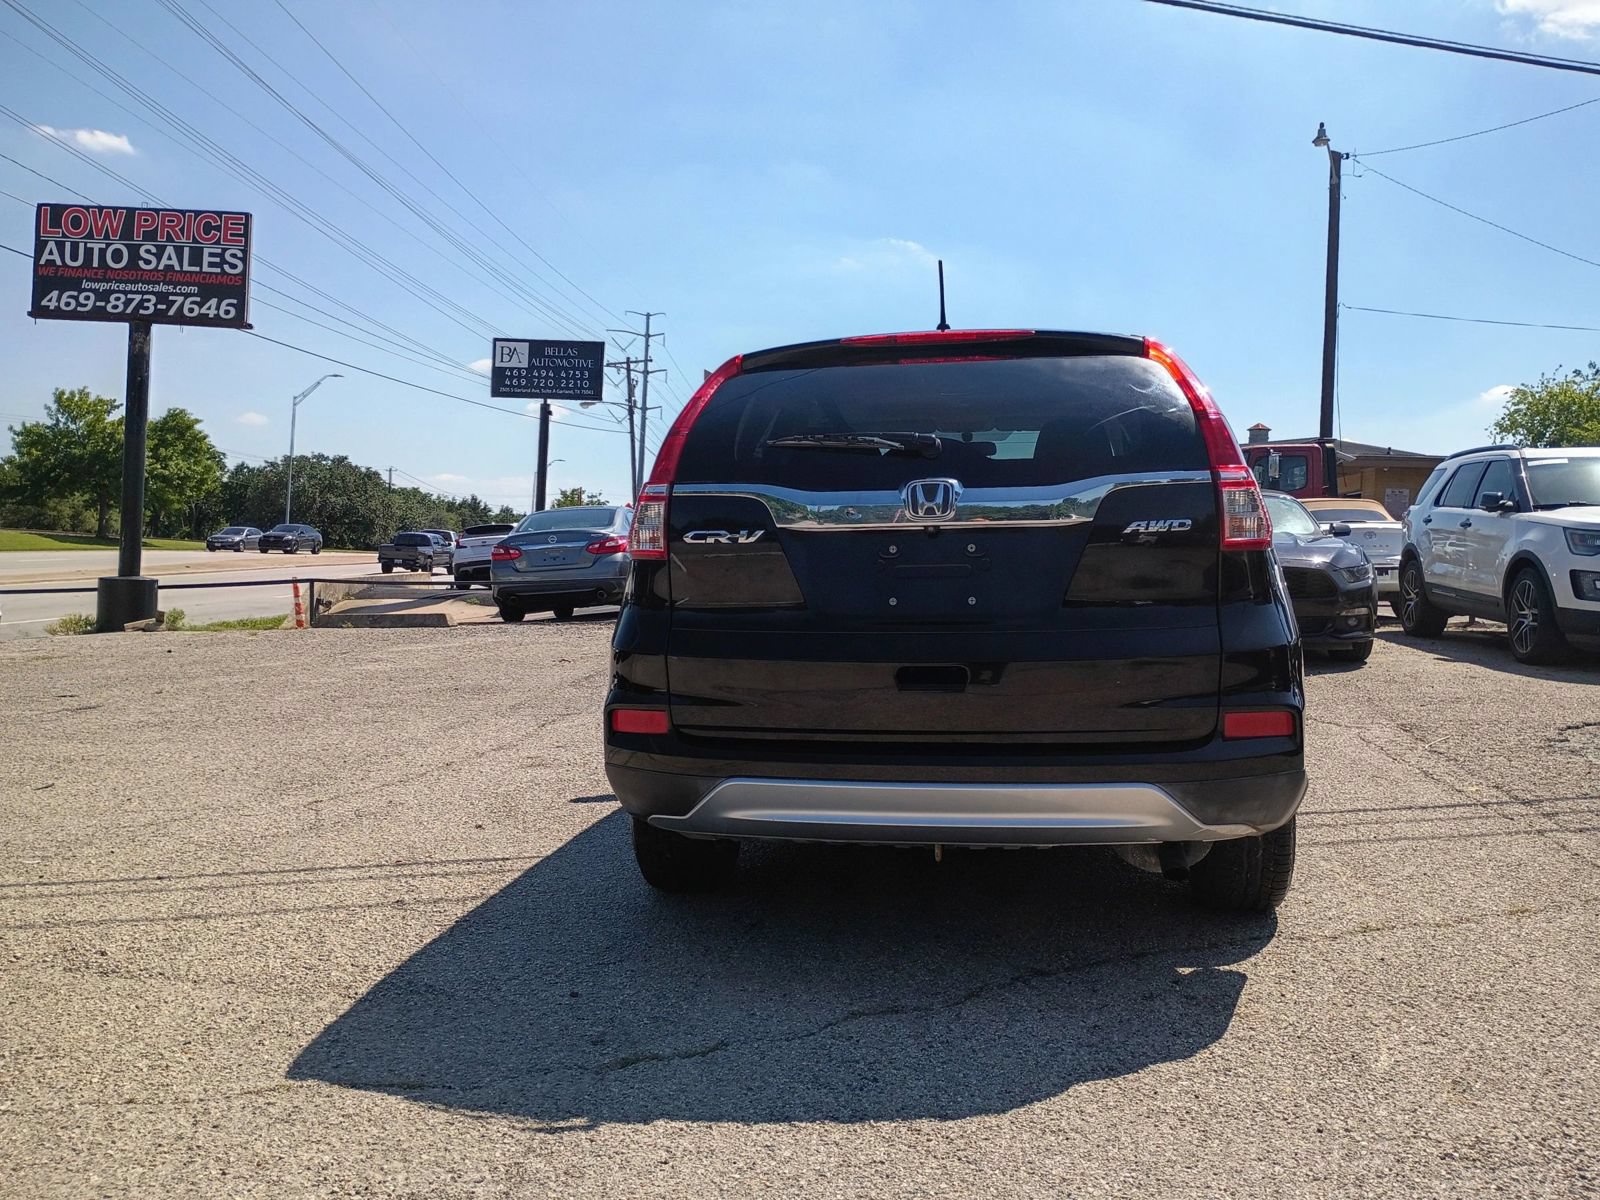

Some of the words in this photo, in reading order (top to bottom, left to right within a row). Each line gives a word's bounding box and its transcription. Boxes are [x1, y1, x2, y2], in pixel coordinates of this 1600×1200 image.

[40, 206, 126, 239] LOW
[134, 210, 245, 246] PRICE
[39, 240, 129, 269] AUTO
[138, 244, 244, 274] SALES
[38, 265, 56, 277] WE
[57, 266, 105, 279] FINANCE
[106, 269, 164, 282] NOSOTROS
[166, 271, 243, 286] FINANCIAMOS
[81, 279, 198, 294] lowpriceautosales.com
[40, 290, 238, 320] 469-873-7646
[544, 347, 578, 357] BELLAS
[530, 357, 595, 369] AUTOMOTIVE
[505, 368, 589, 379] 469.494.4753
[504, 378, 590, 388] 469.720.2210
[1122, 519, 1192, 533] AWD
[682, 530, 765, 543] CR-V
